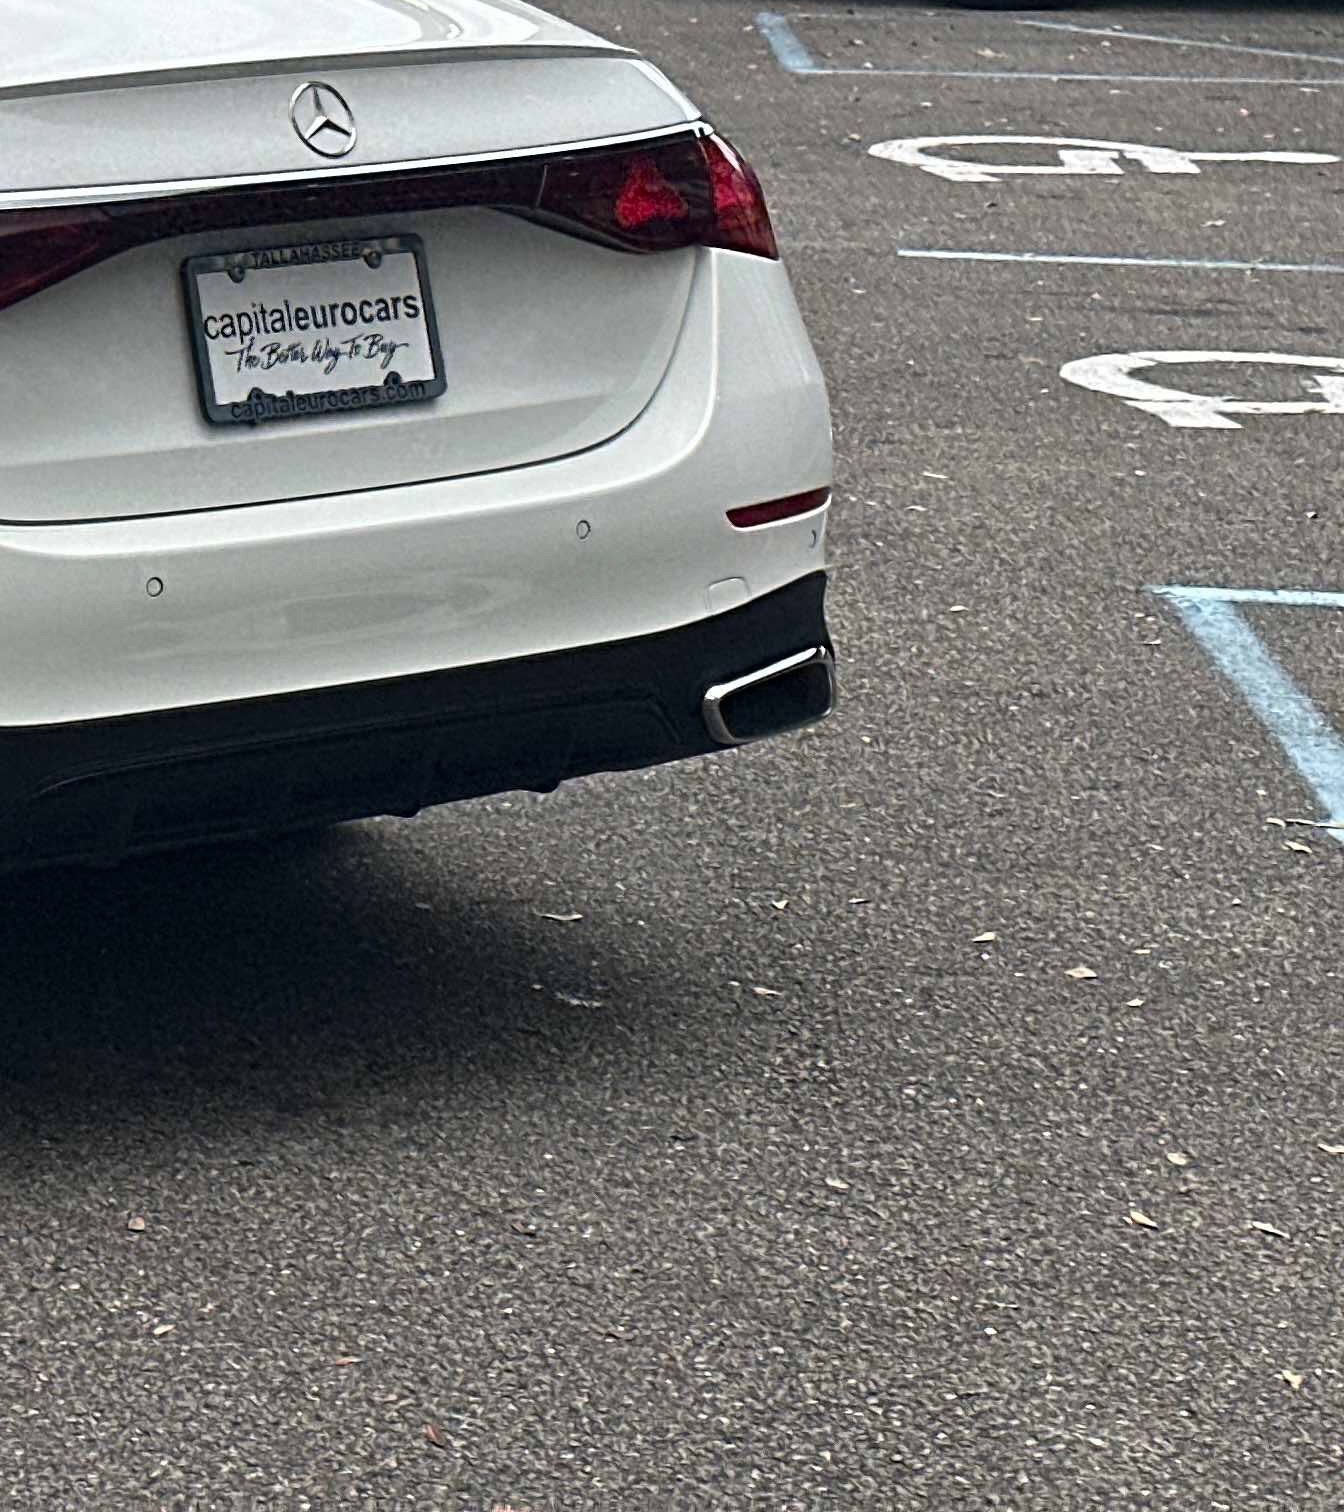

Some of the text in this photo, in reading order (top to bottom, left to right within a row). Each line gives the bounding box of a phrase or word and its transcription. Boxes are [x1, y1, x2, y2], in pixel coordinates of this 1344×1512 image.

[251, 240, 362, 267] TALLAHASSEE
[203, 294, 421, 344] capitaleurocars
[224, 335, 261, 373] The
[311, 337, 346, 375] Way
[340, 333, 363, 360] To
[362, 333, 409, 370] Buy
[230, 381, 427, 421] capitaleurocars.com
